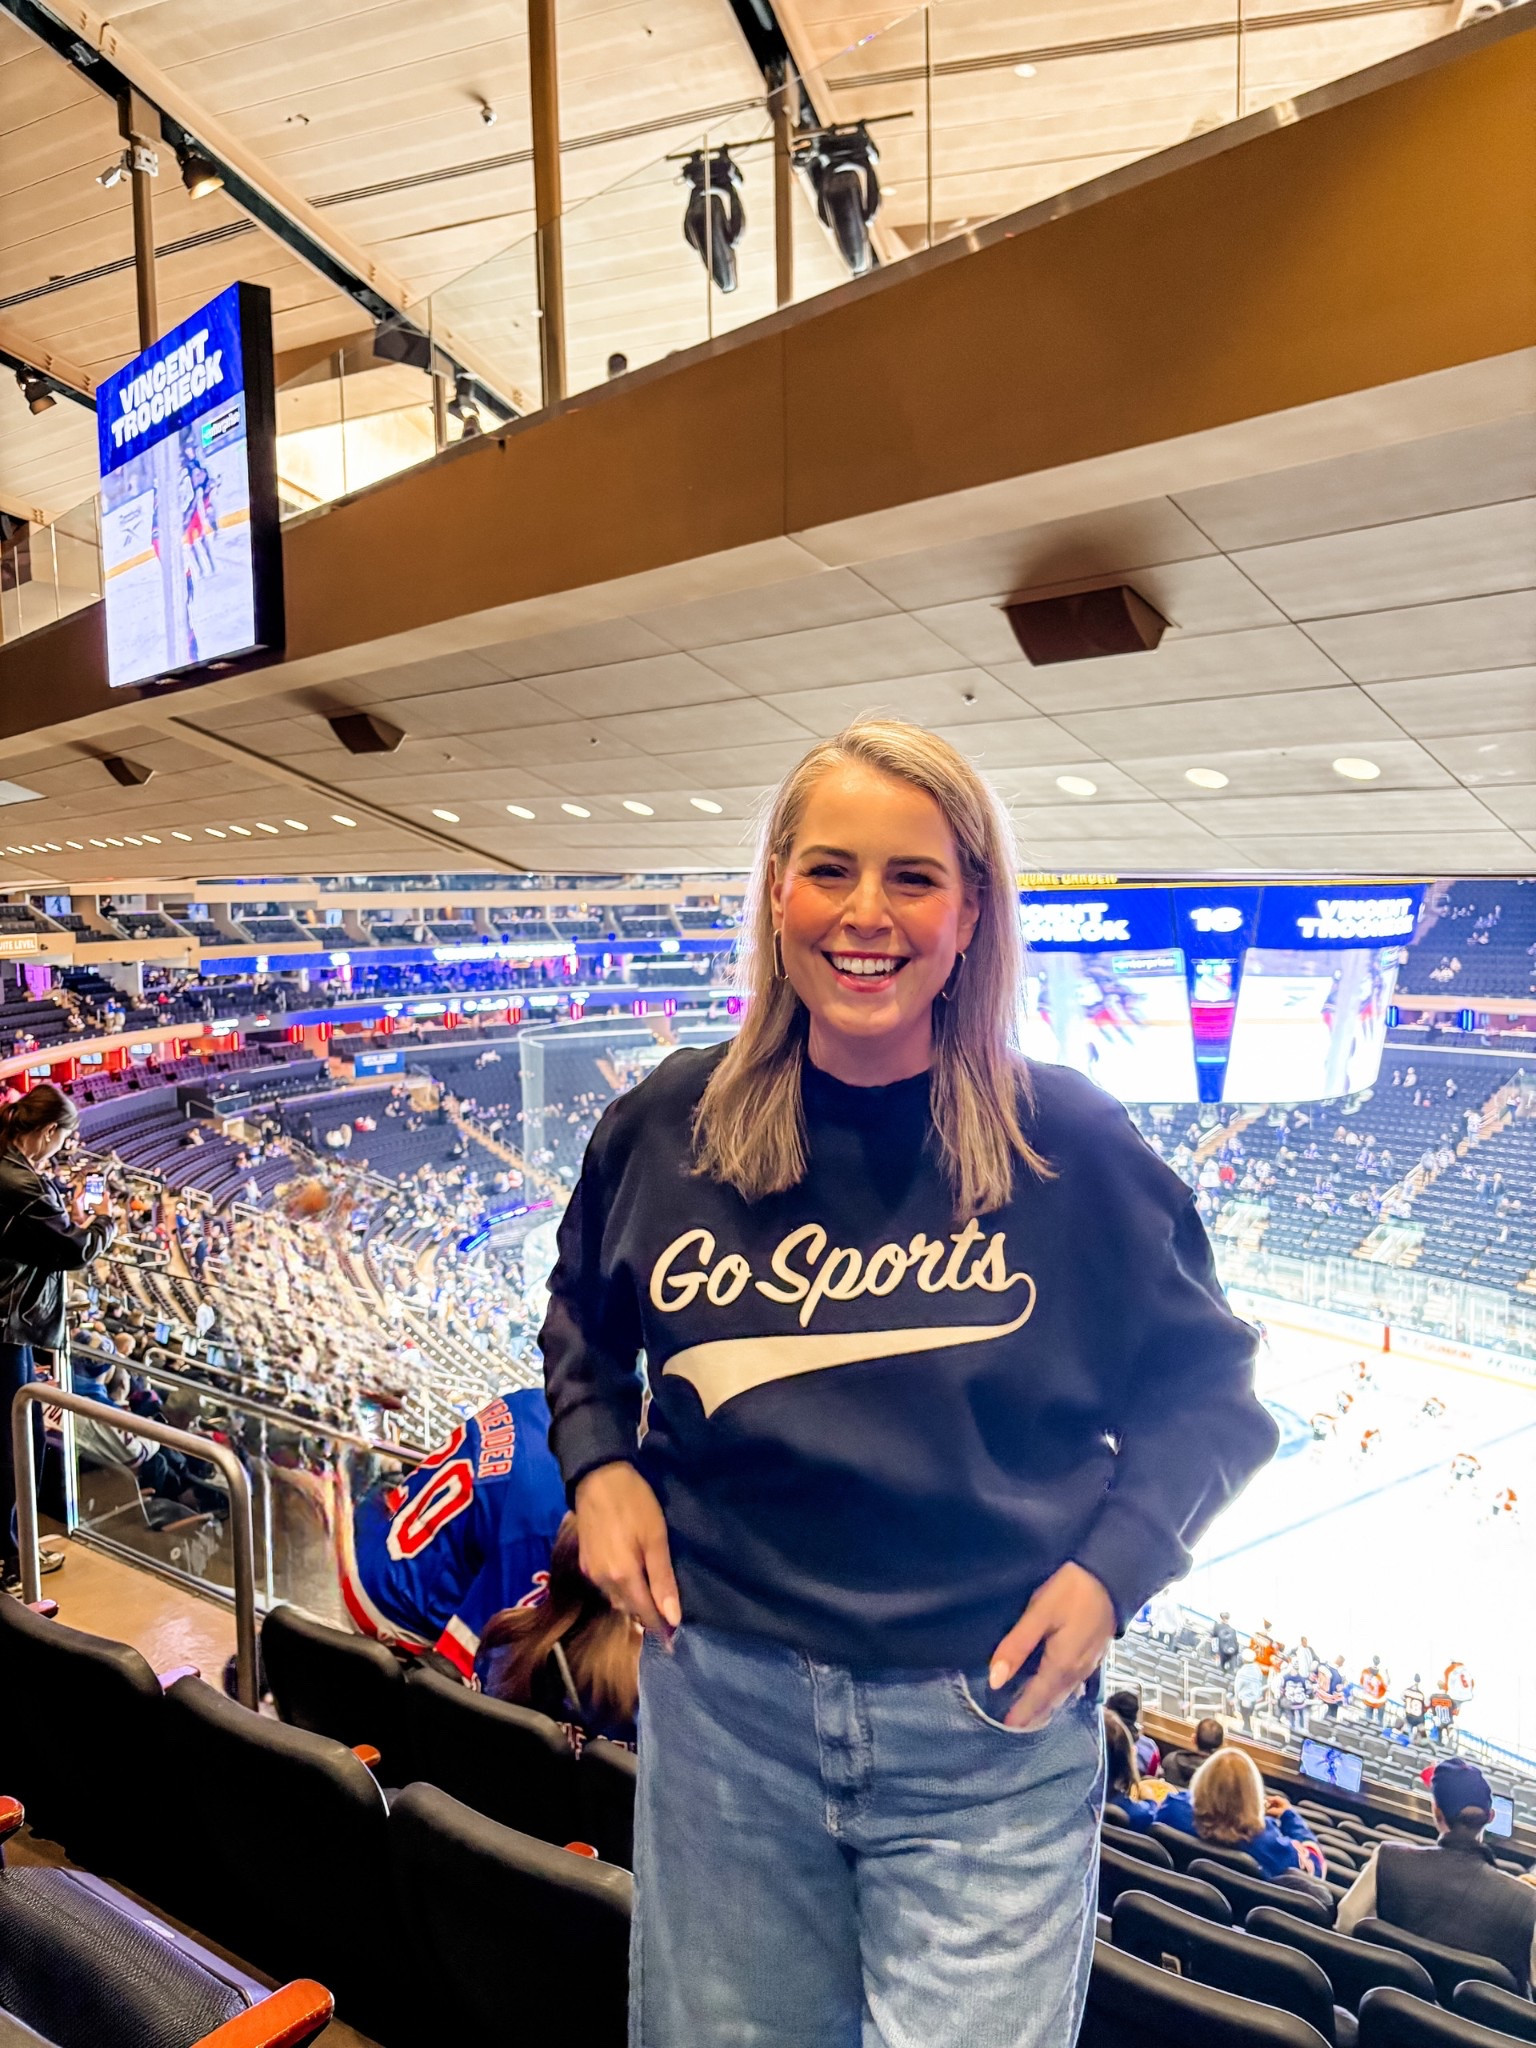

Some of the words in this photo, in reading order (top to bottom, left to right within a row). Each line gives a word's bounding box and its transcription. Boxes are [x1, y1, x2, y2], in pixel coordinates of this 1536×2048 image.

[111, 349, 224, 448] TROCHECK
[119, 328, 209, 414] VINCENT
[14, 939, 36, 950] LEVEL
[1190, 906, 1243, 932] 16
[649, 1228, 751, 1313] Go
[755, 1217, 1037, 1328] Sports
